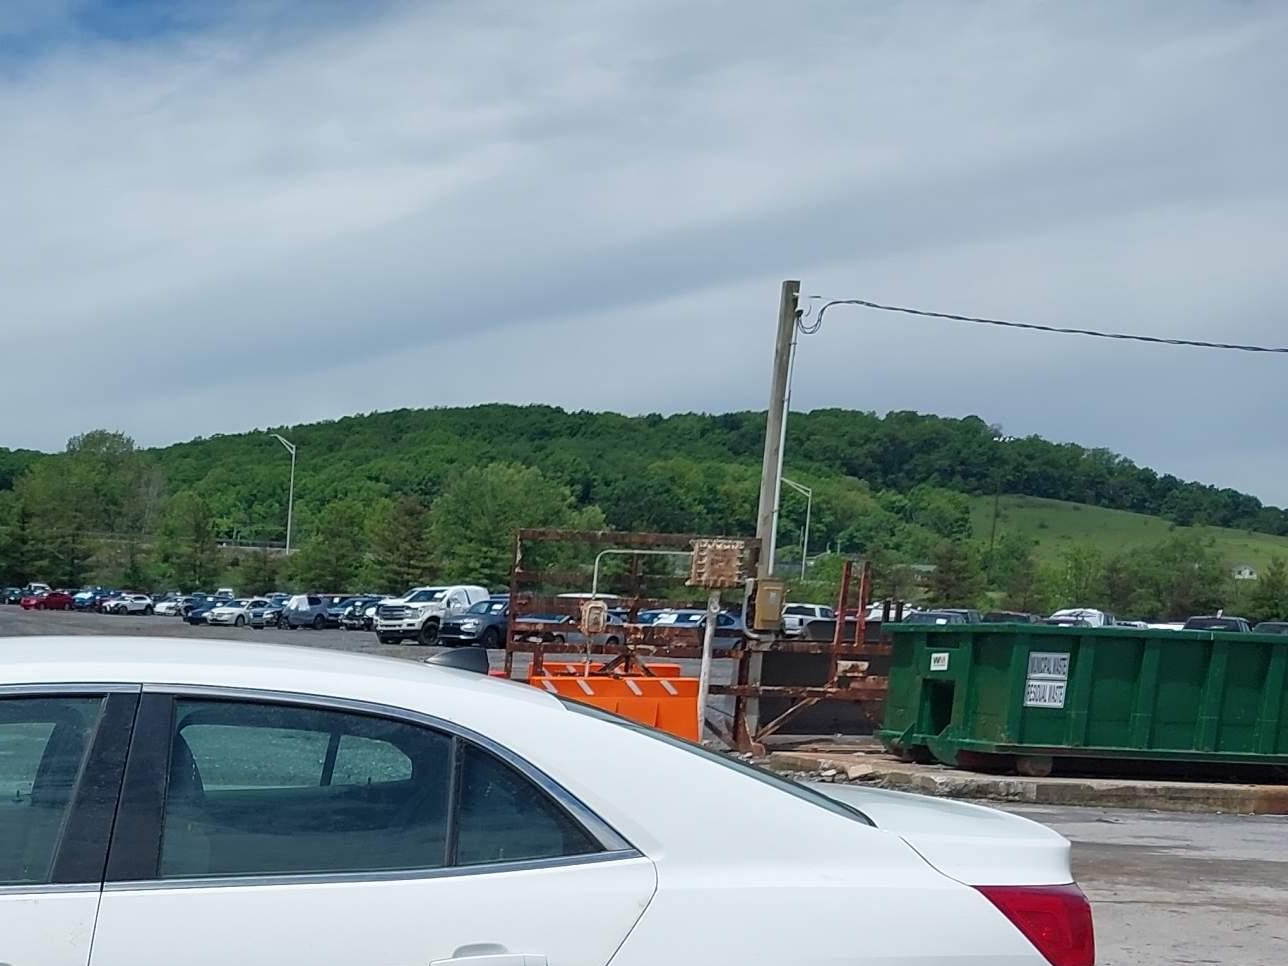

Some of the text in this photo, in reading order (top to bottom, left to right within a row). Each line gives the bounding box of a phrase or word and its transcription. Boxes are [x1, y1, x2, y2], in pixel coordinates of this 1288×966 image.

[1053, 657, 1068, 675] WASTE
[1027, 684, 1064, 704] RESIDUAL WASTE
